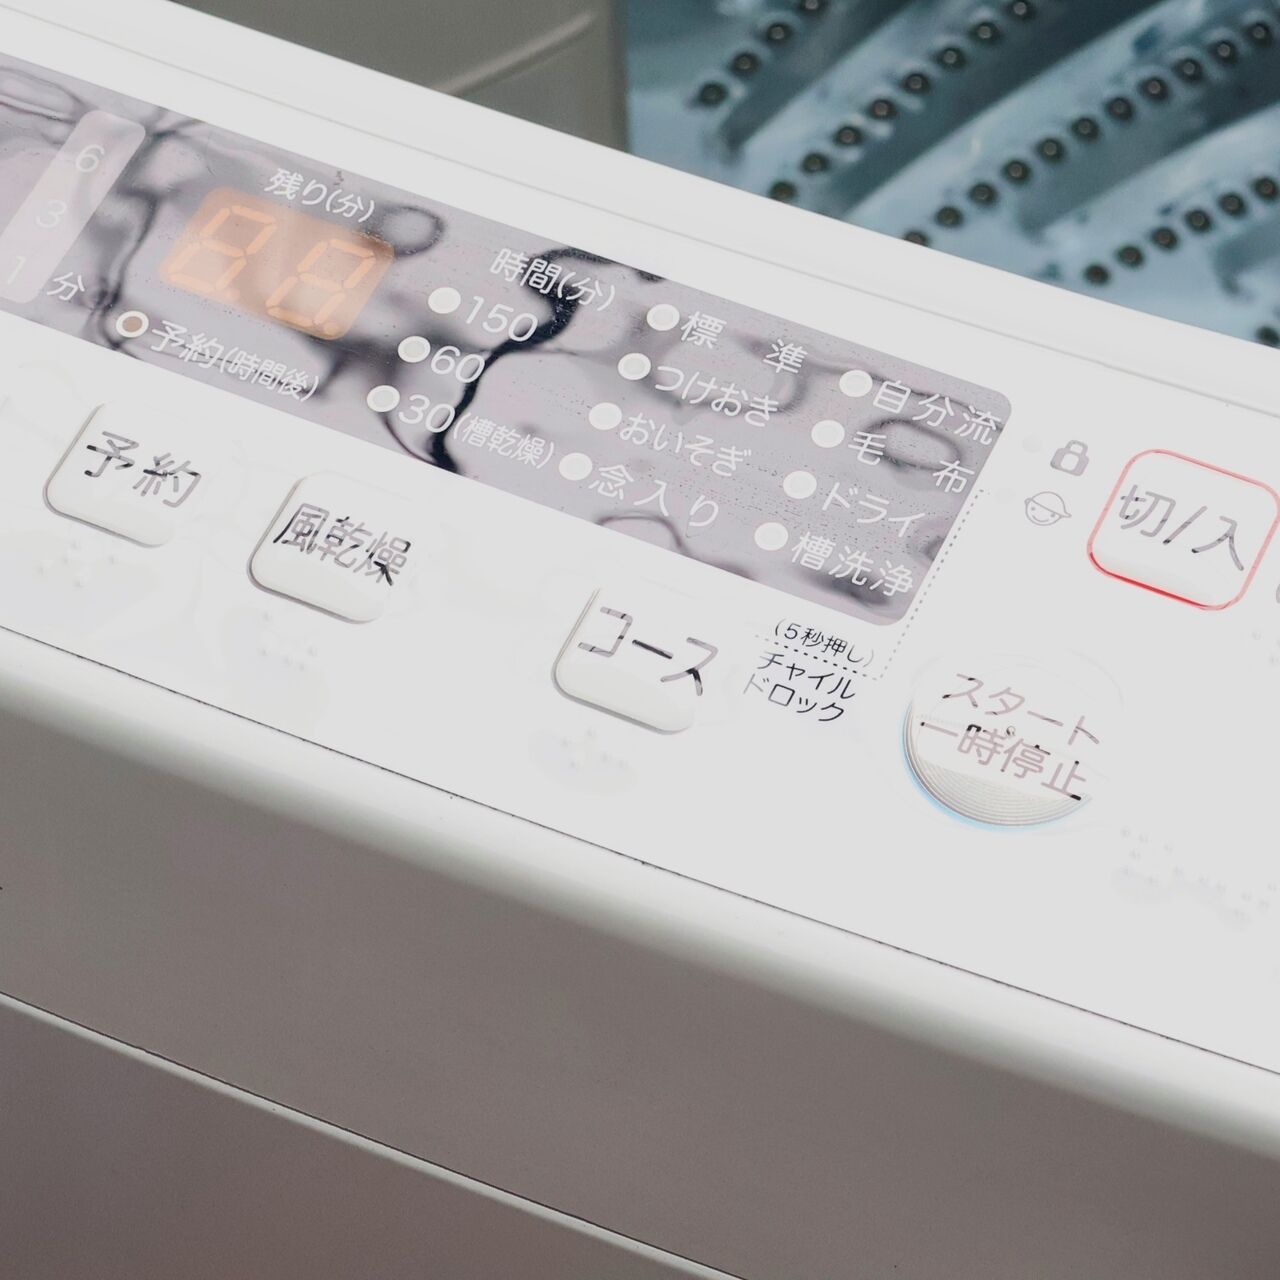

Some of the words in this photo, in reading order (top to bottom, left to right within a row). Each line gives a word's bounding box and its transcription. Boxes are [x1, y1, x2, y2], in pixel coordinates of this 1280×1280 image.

[75, 143, 106, 174] 6
[35, 199, 68, 229] 3
[263, 167, 376, 224] 残り(分)
[489, 247, 617, 312] 時間(分)
[465, 294, 539, 343] 150
[429, 345, 486, 384] 60
[654, 364, 780, 428] つけおき
[619, 412, 753, 477] おいそぎ
[872, 379, 1003, 446] 自分流
[83, 430, 202, 509] 予約
[587, 463, 720, 527] 念入り
[821, 481, 926, 538] ドライ
[1117, 483, 1246, 572] 切/入
[272, 502, 412, 587] 風乾燥
[790, 531, 914, 597] 槽洗浄
[577, 605, 720, 697] コース
[774, 618, 875, 668] (5秒押し)
[941, 672, 1101, 747] スタート
[919, 719, 1088, 802] 一時停止
